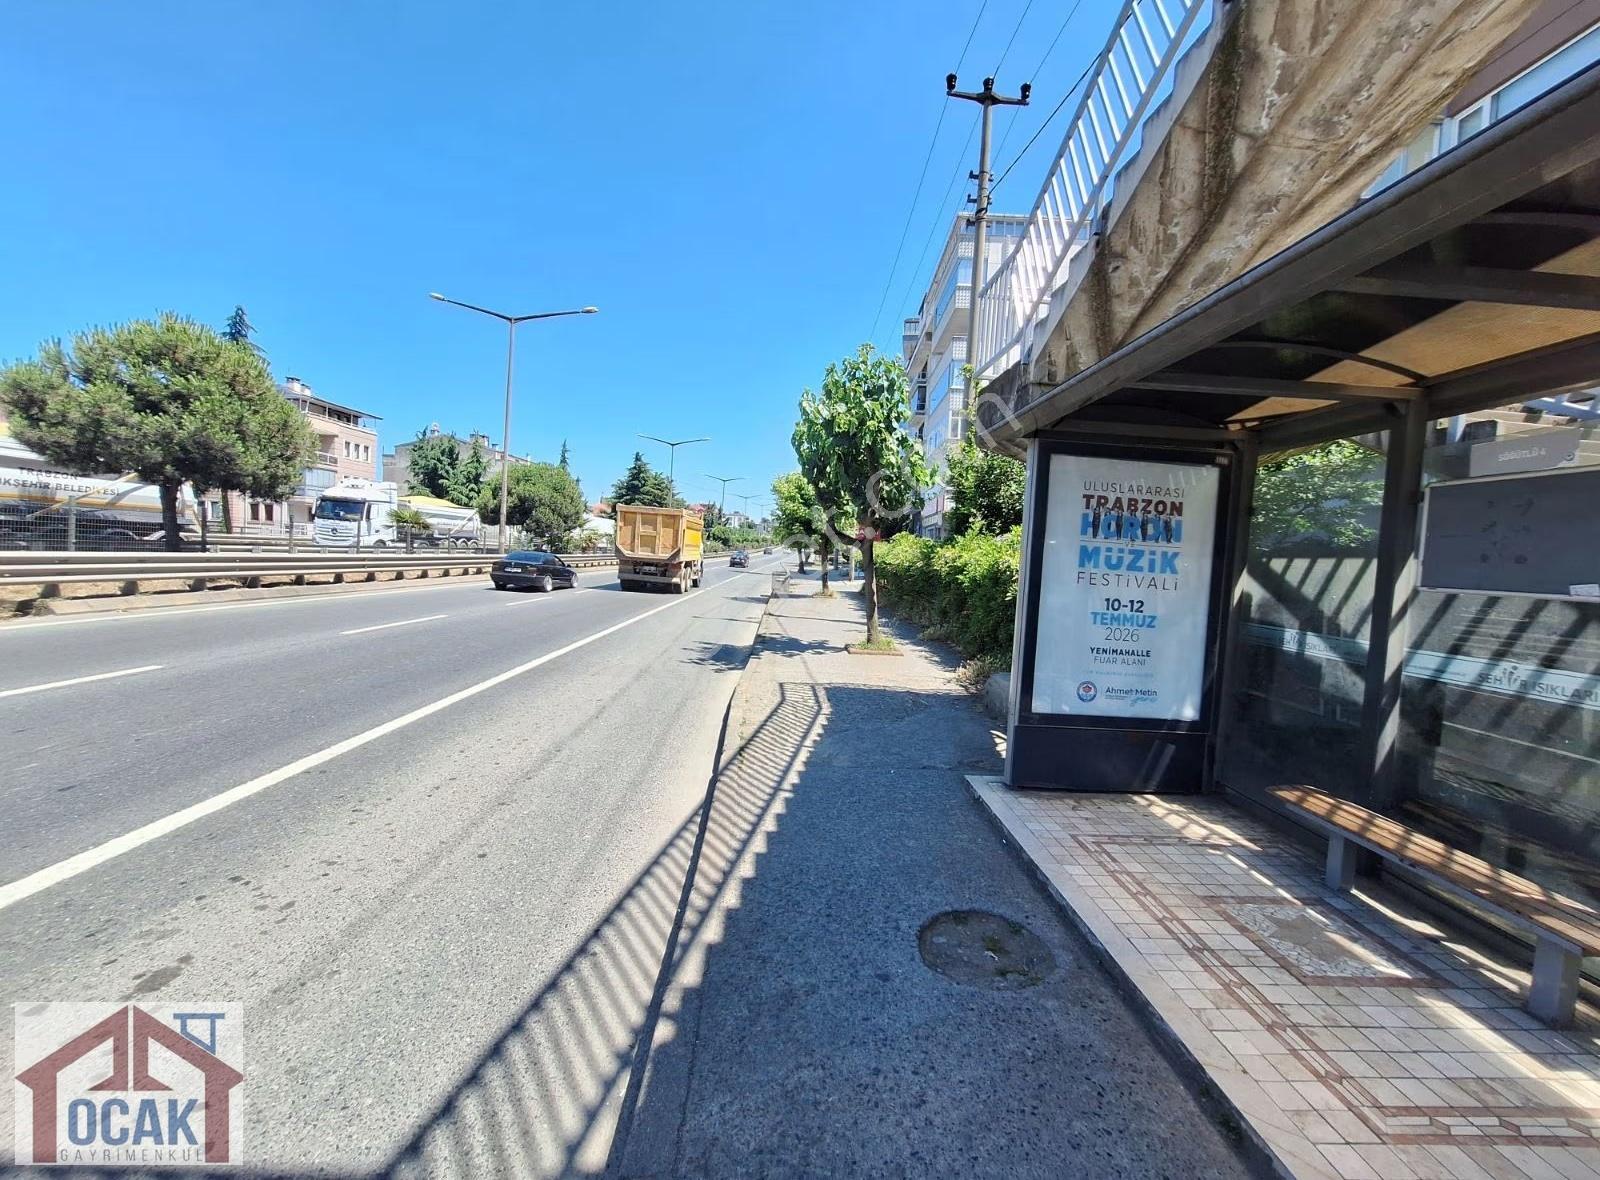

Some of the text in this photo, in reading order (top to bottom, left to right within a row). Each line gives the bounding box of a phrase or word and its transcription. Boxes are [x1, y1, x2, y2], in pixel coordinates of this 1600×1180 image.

[1083, 480, 1185, 499] ULUSLARARASI
[1082, 494, 1184, 517] TRABZON
[1104, 598, 1145, 614] 10-12
[1090, 611, 1157, 629] TEMMUZ
[1104, 627, 1140, 643] 2026
[1089, 646, 1152, 658] YENİMAHALLE
[1093, 656, 1146, 666] FUAR ALANI
[1105, 686, 1133, 696] Ahmet
[1135, 688, 1158, 697] Metin
